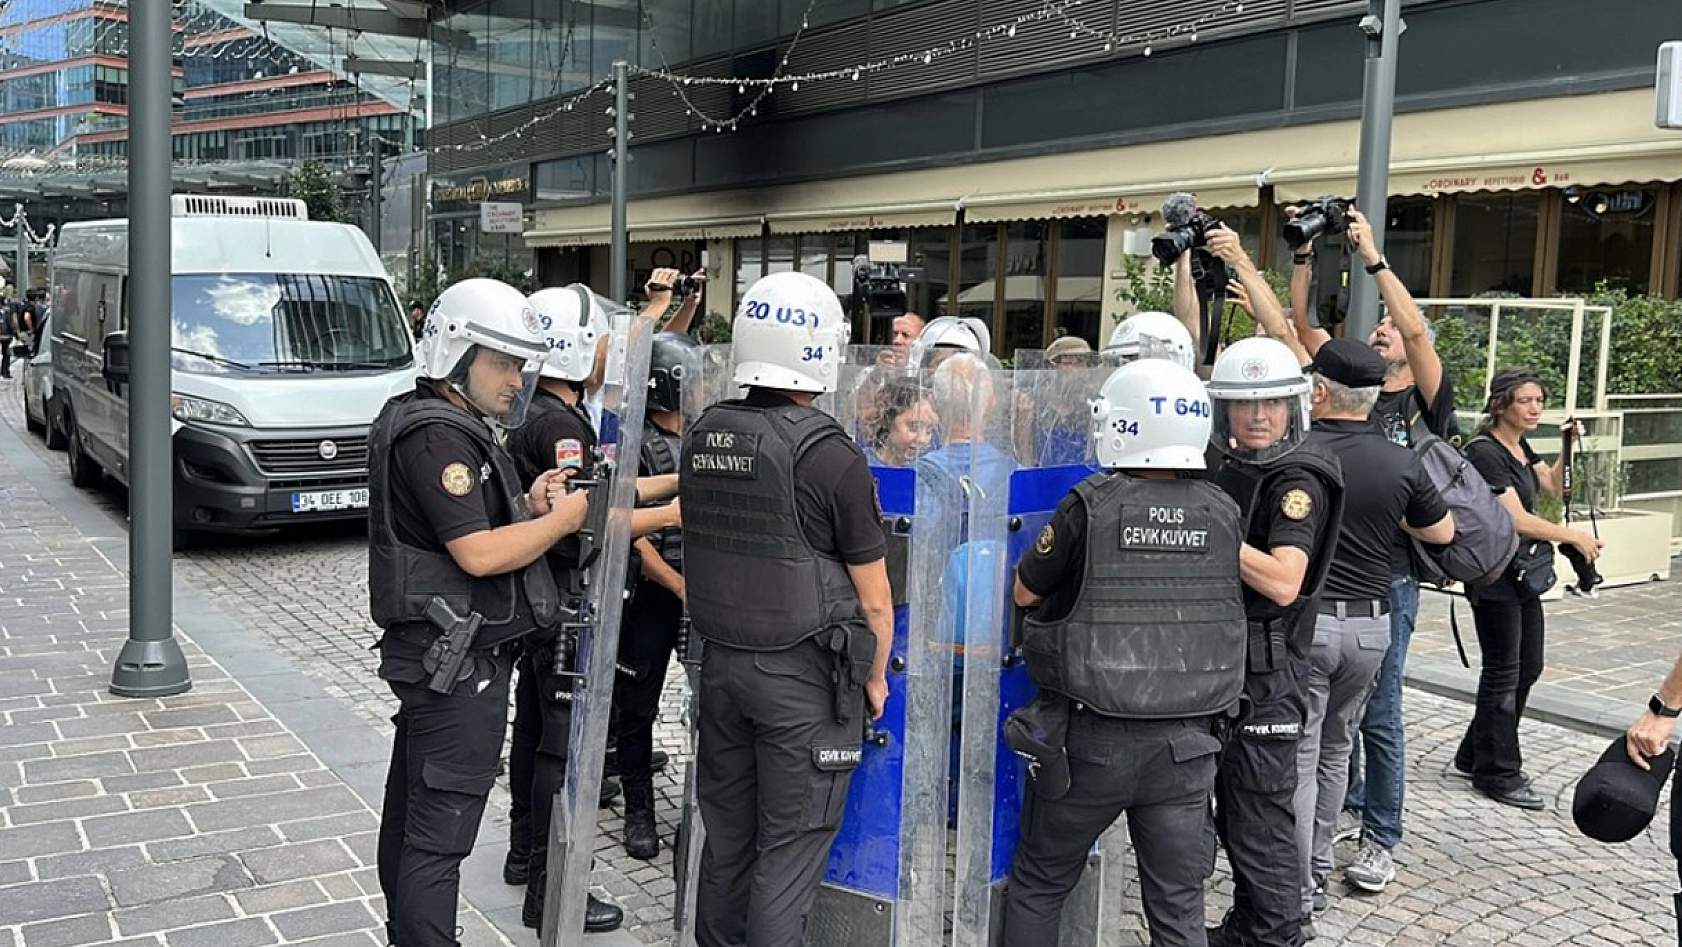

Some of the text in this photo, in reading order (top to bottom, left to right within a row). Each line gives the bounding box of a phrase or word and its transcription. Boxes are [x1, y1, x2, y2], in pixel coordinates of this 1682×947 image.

[1431, 177, 1477, 189] ORDINARY
[1532, 167, 1547, 185] &
[745, 300, 770, 320] 20
[547, 337, 566, 351] 34
[801, 345, 823, 361] 34
[1148, 396, 1210, 418] T 640
[1117, 419, 1139, 436] 34
[301, 494, 315, 508] 34
[1161, 528, 1207, 547] KUVVET
